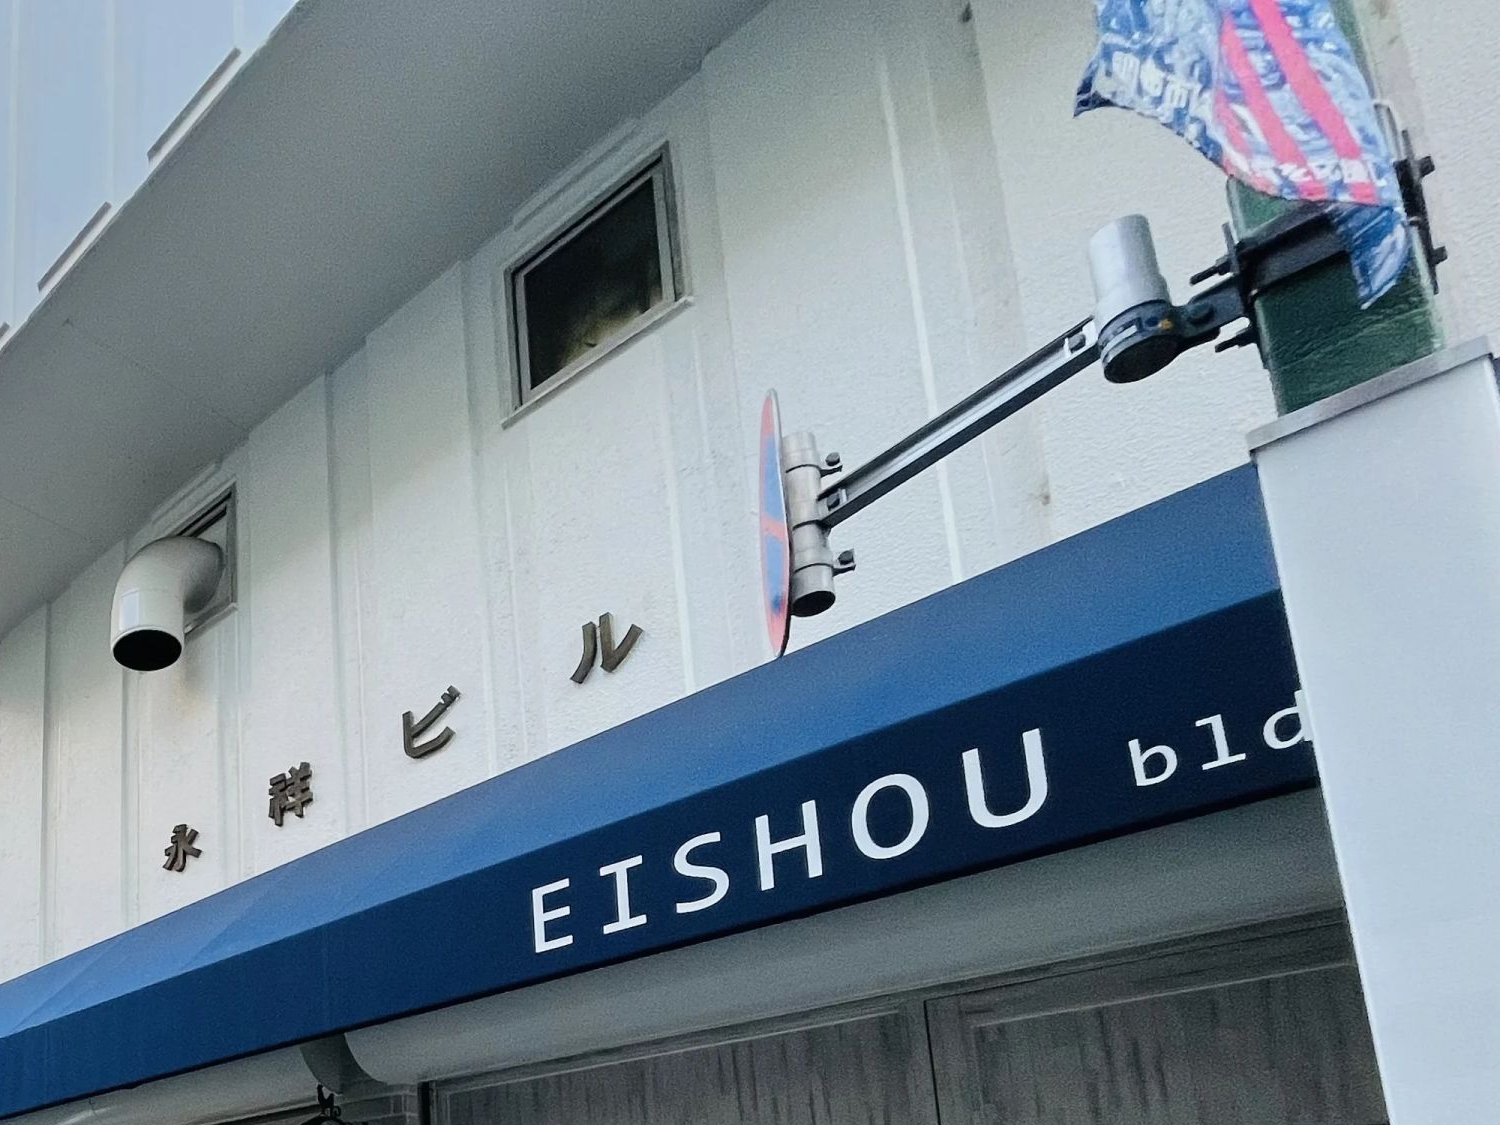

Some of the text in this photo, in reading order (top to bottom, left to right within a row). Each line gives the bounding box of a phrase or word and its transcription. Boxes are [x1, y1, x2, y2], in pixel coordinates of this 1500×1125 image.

[162, 611, 644, 873] 永祥ビル
[531, 727, 1050, 953] EISHOU
